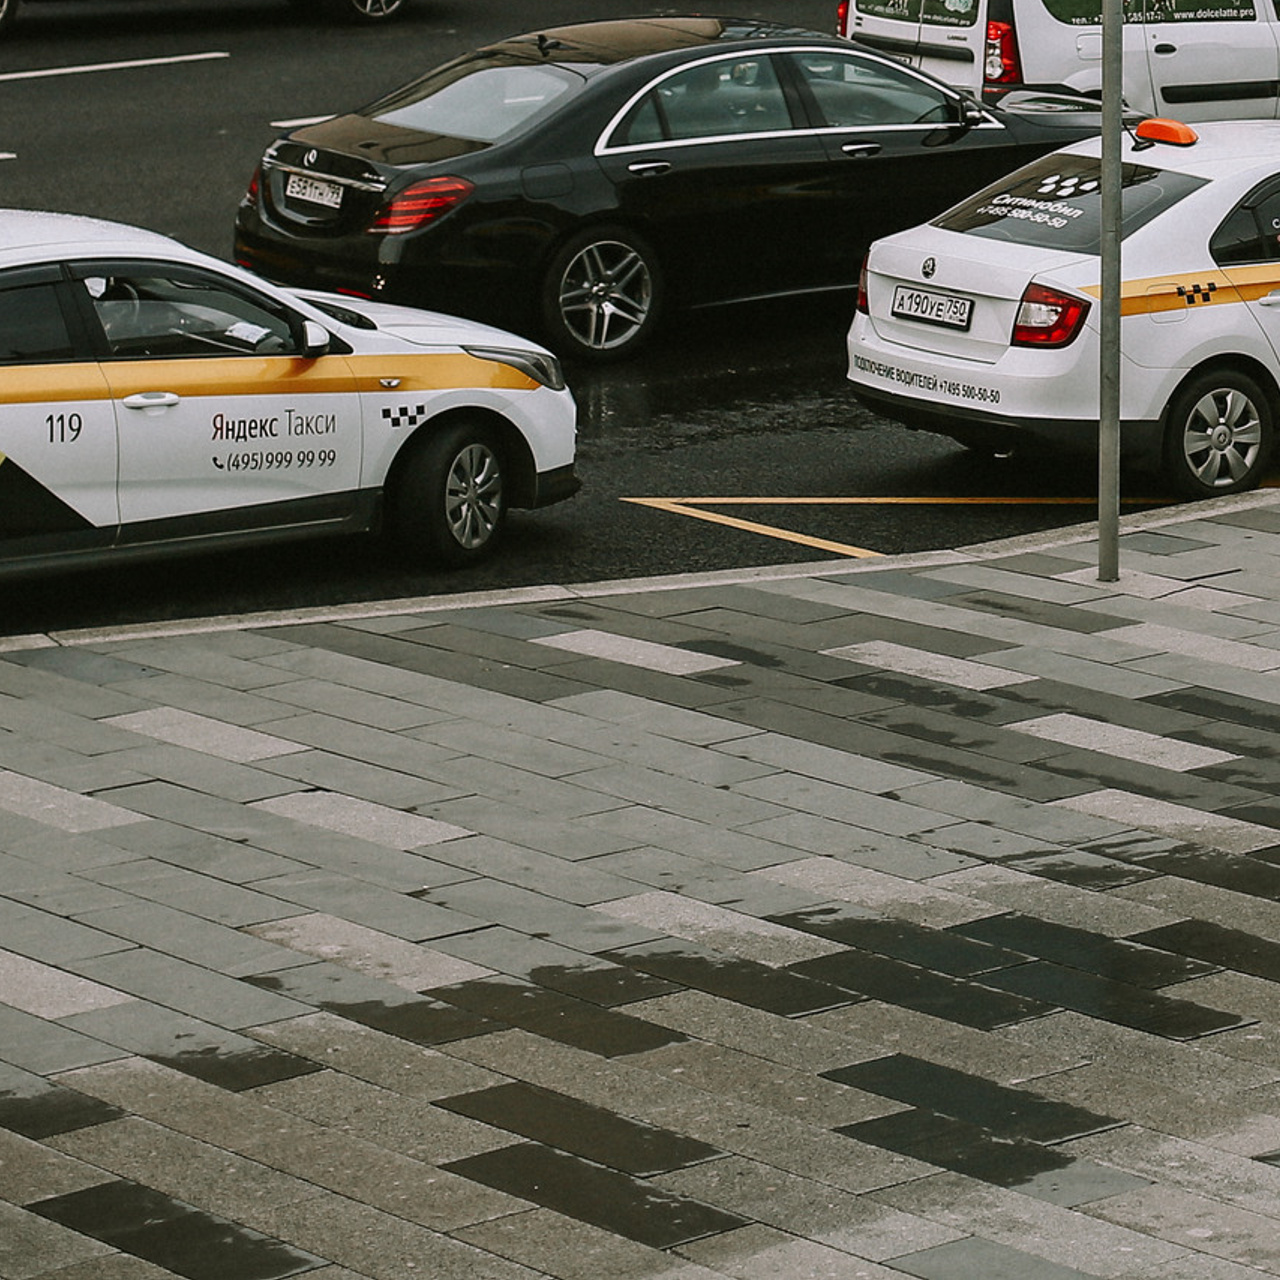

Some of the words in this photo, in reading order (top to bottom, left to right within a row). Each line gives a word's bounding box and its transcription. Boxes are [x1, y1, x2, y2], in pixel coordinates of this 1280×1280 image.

[1173, 8, 1255, 21] www.dolcelatte.pro
[992, 194, 1084, 218] Ситимобил
[896, 368, 938, 393] ВОДИТЕЛЕЙ
[961, 385, 1001, 404] 500-50-50
[46, 412, 83, 443] 119
[211, 413, 279, 443] Яндекс
[284, 408, 336, 436] Такси
